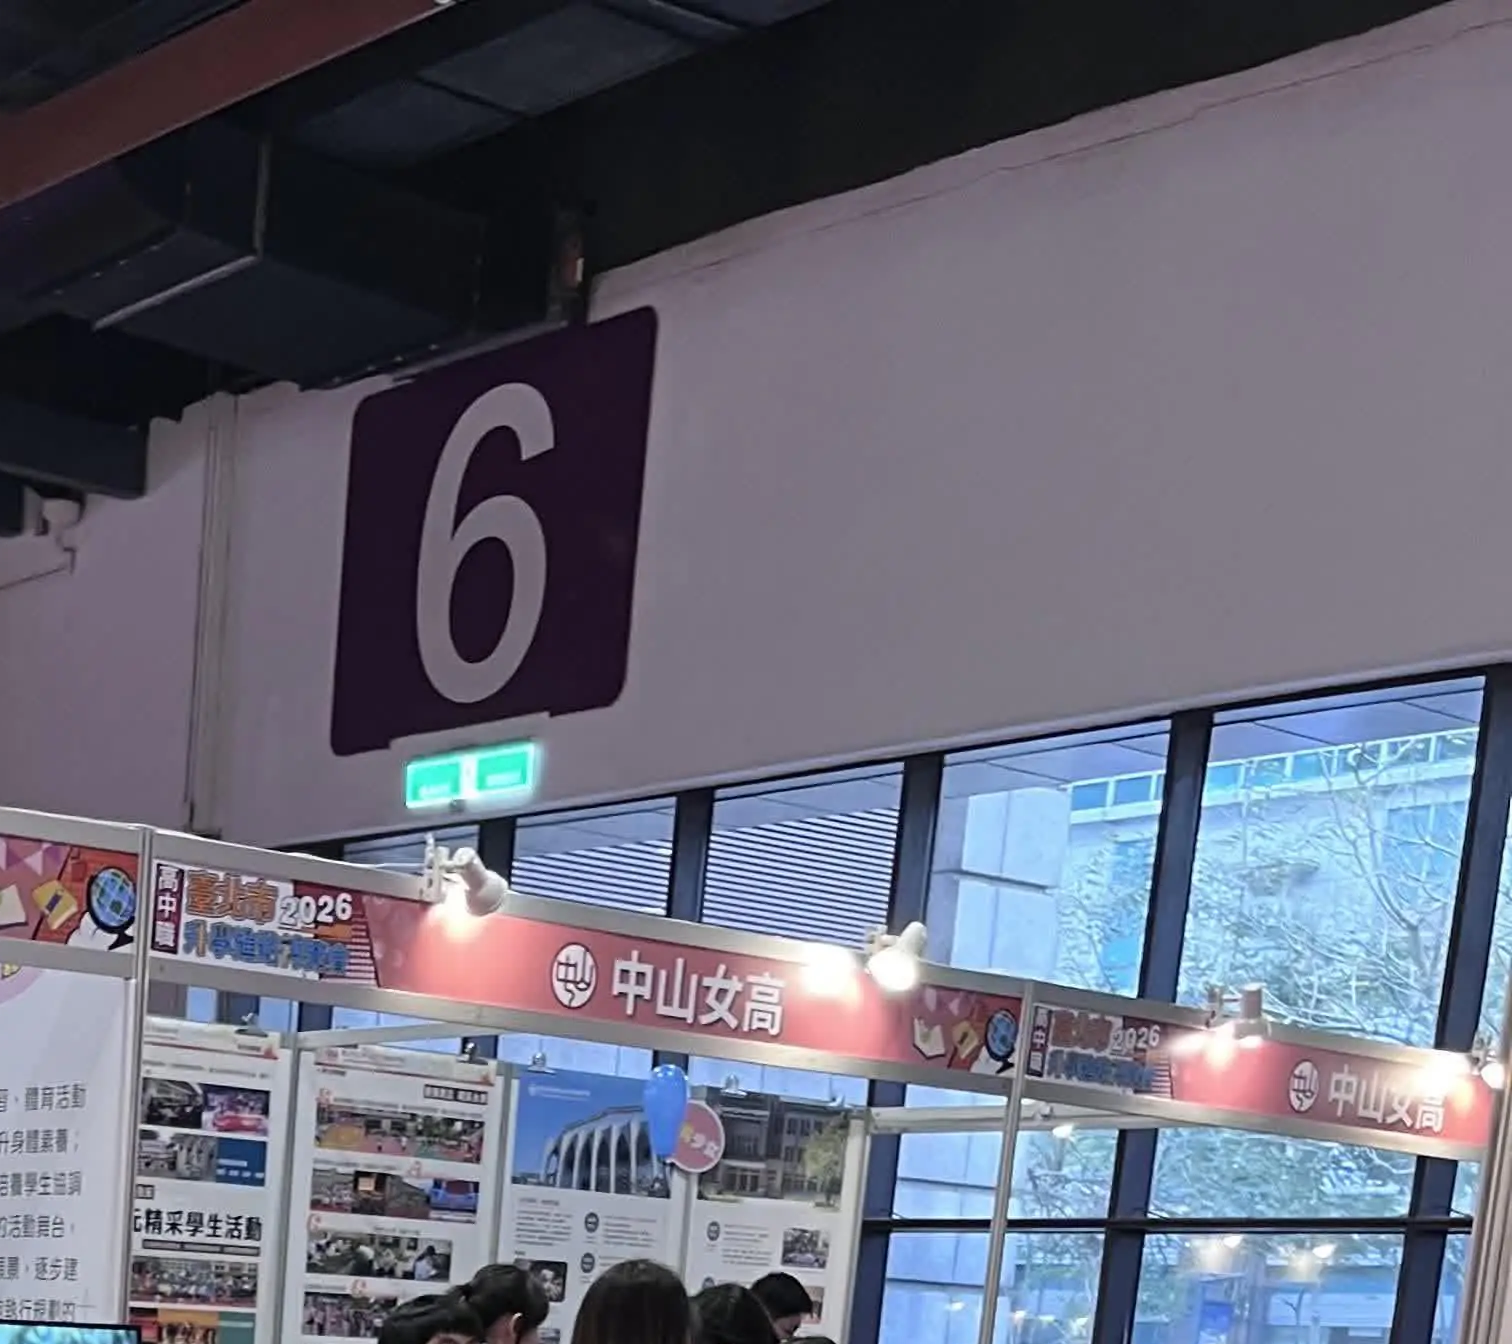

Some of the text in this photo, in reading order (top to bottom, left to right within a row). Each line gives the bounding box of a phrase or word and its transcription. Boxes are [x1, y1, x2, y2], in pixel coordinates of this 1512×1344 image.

[416, 381, 556, 704] 6
[278, 893, 353, 926] 2026
[611, 950, 786, 1036] 中山女高
[1109, 1024, 1161, 1051] 2026
[1329, 1065, 1445, 1133] 中山女高
